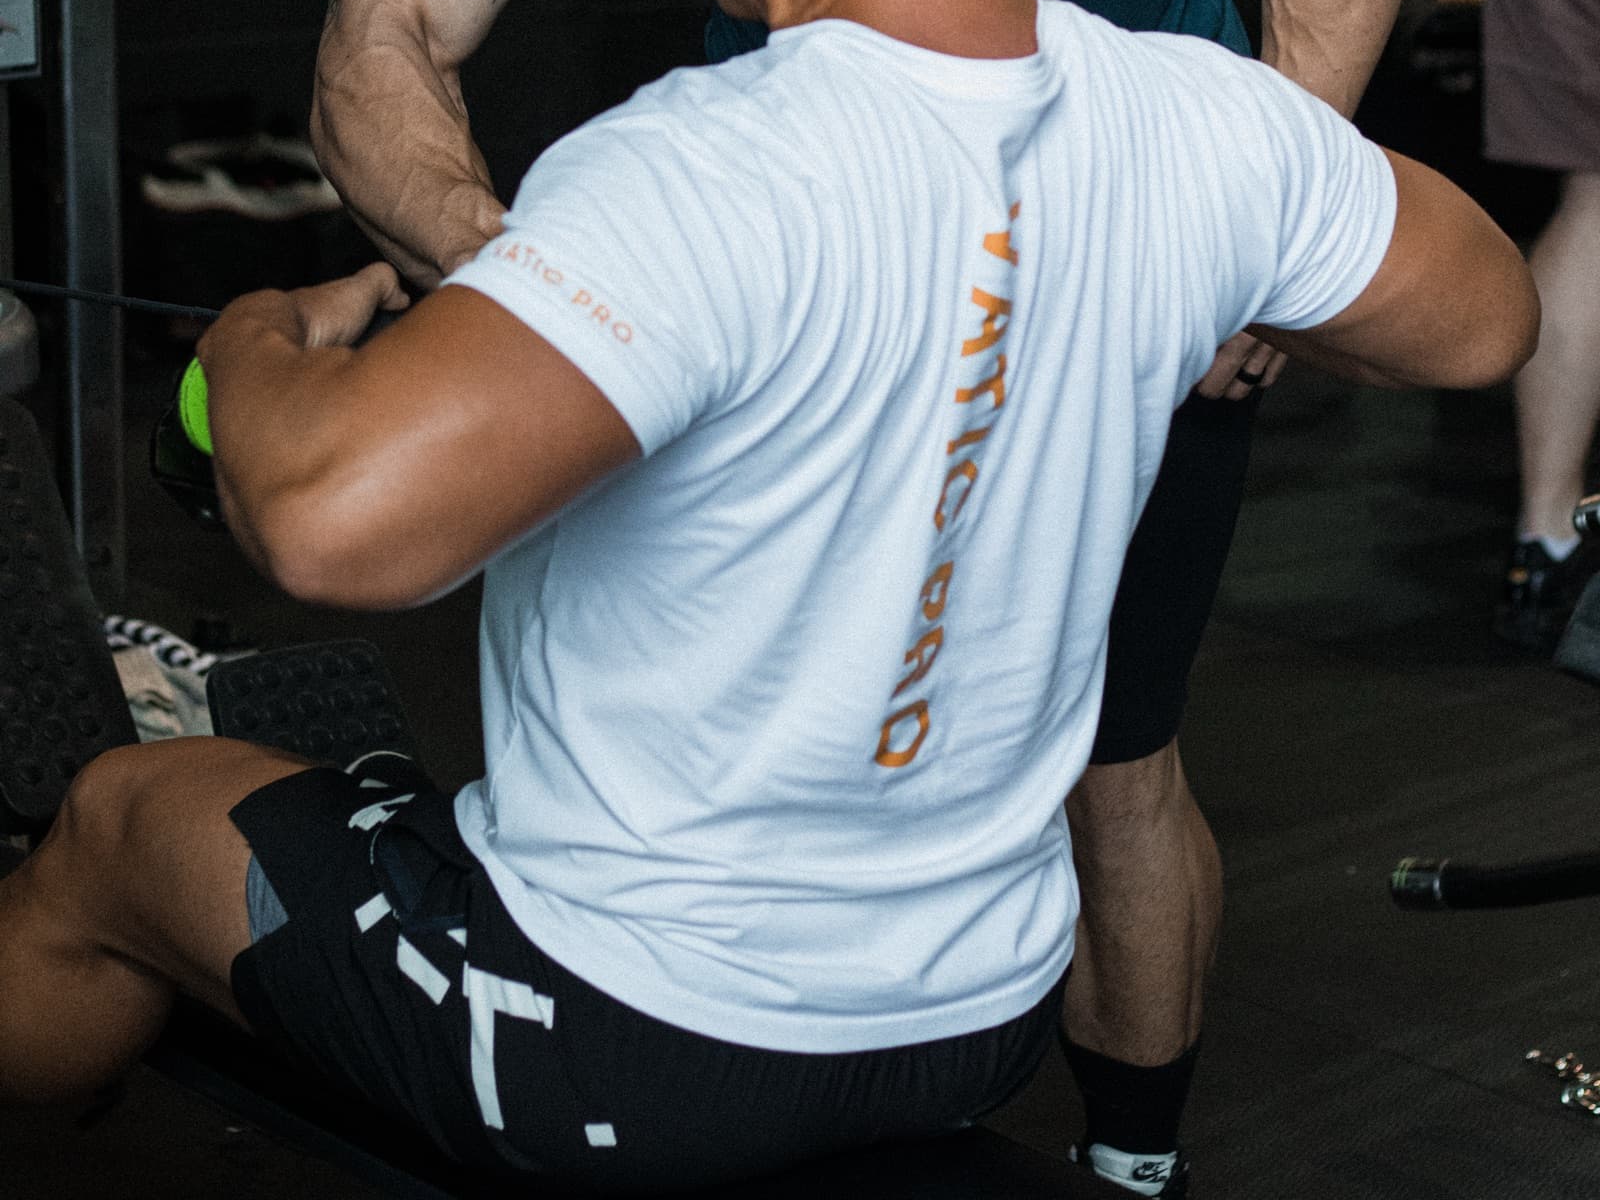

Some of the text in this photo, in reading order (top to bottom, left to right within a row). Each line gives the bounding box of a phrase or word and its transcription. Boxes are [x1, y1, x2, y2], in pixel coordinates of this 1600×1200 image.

[571, 289, 633, 343] PRO
[874, 200, 1020, 767] VATIC PRO
